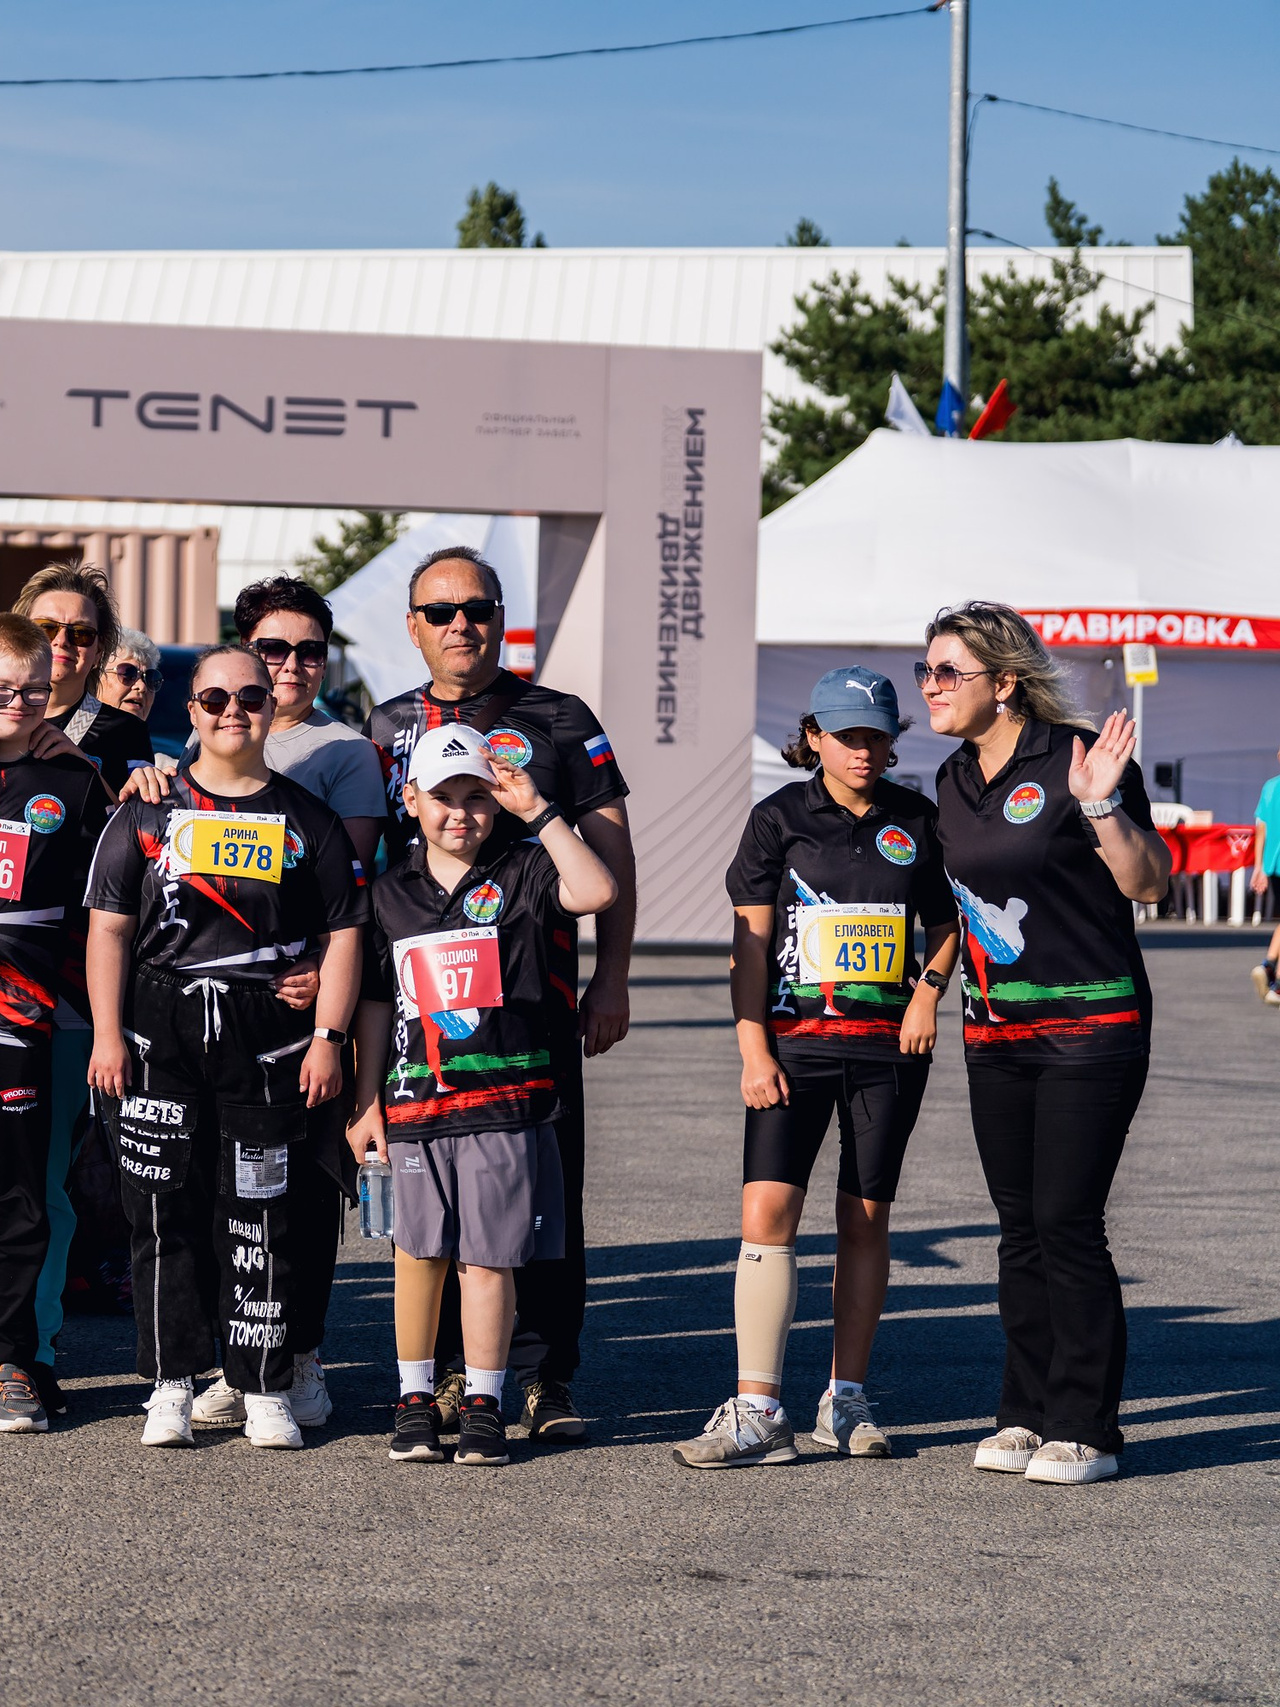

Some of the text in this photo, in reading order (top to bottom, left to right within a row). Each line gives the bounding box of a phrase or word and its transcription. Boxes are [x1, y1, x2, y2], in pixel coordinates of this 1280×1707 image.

[65, 388, 419, 438] TENET
[681, 408, 705, 639] ДВИЖЕНИЕМ
[656, 512, 681, 744] ДВИЖЕНИЕМ
[441, 749, 469, 758] adidas
[223, 828, 259, 841] АРИНА
[211, 841, 273, 871] 1378
[834, 924, 895, 938] ЕЛИЗАВЕТА
[834, 941, 896, 972] 4317
[441, 966, 474, 1000] 97
[3, 1088, 37, 1100] PRODUCE
[119, 1096, 186, 1126] MEETS
